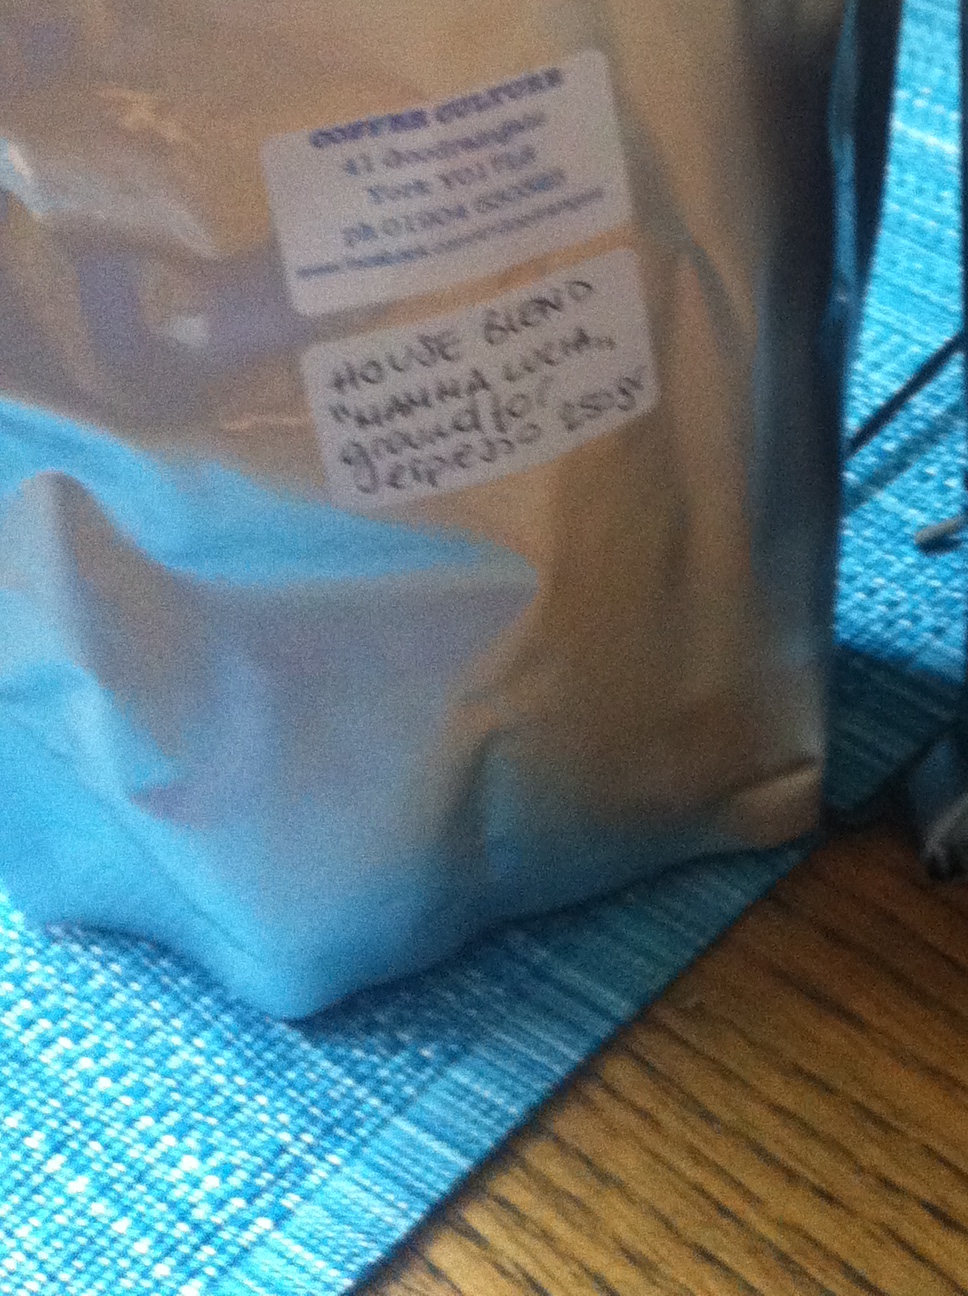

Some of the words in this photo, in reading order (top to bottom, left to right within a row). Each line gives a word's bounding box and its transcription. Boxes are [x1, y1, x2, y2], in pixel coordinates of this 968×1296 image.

[331, 329, 462, 393] HOUSE
[483, 280, 593, 345] BLEND
[339, 396, 484, 494] ground
